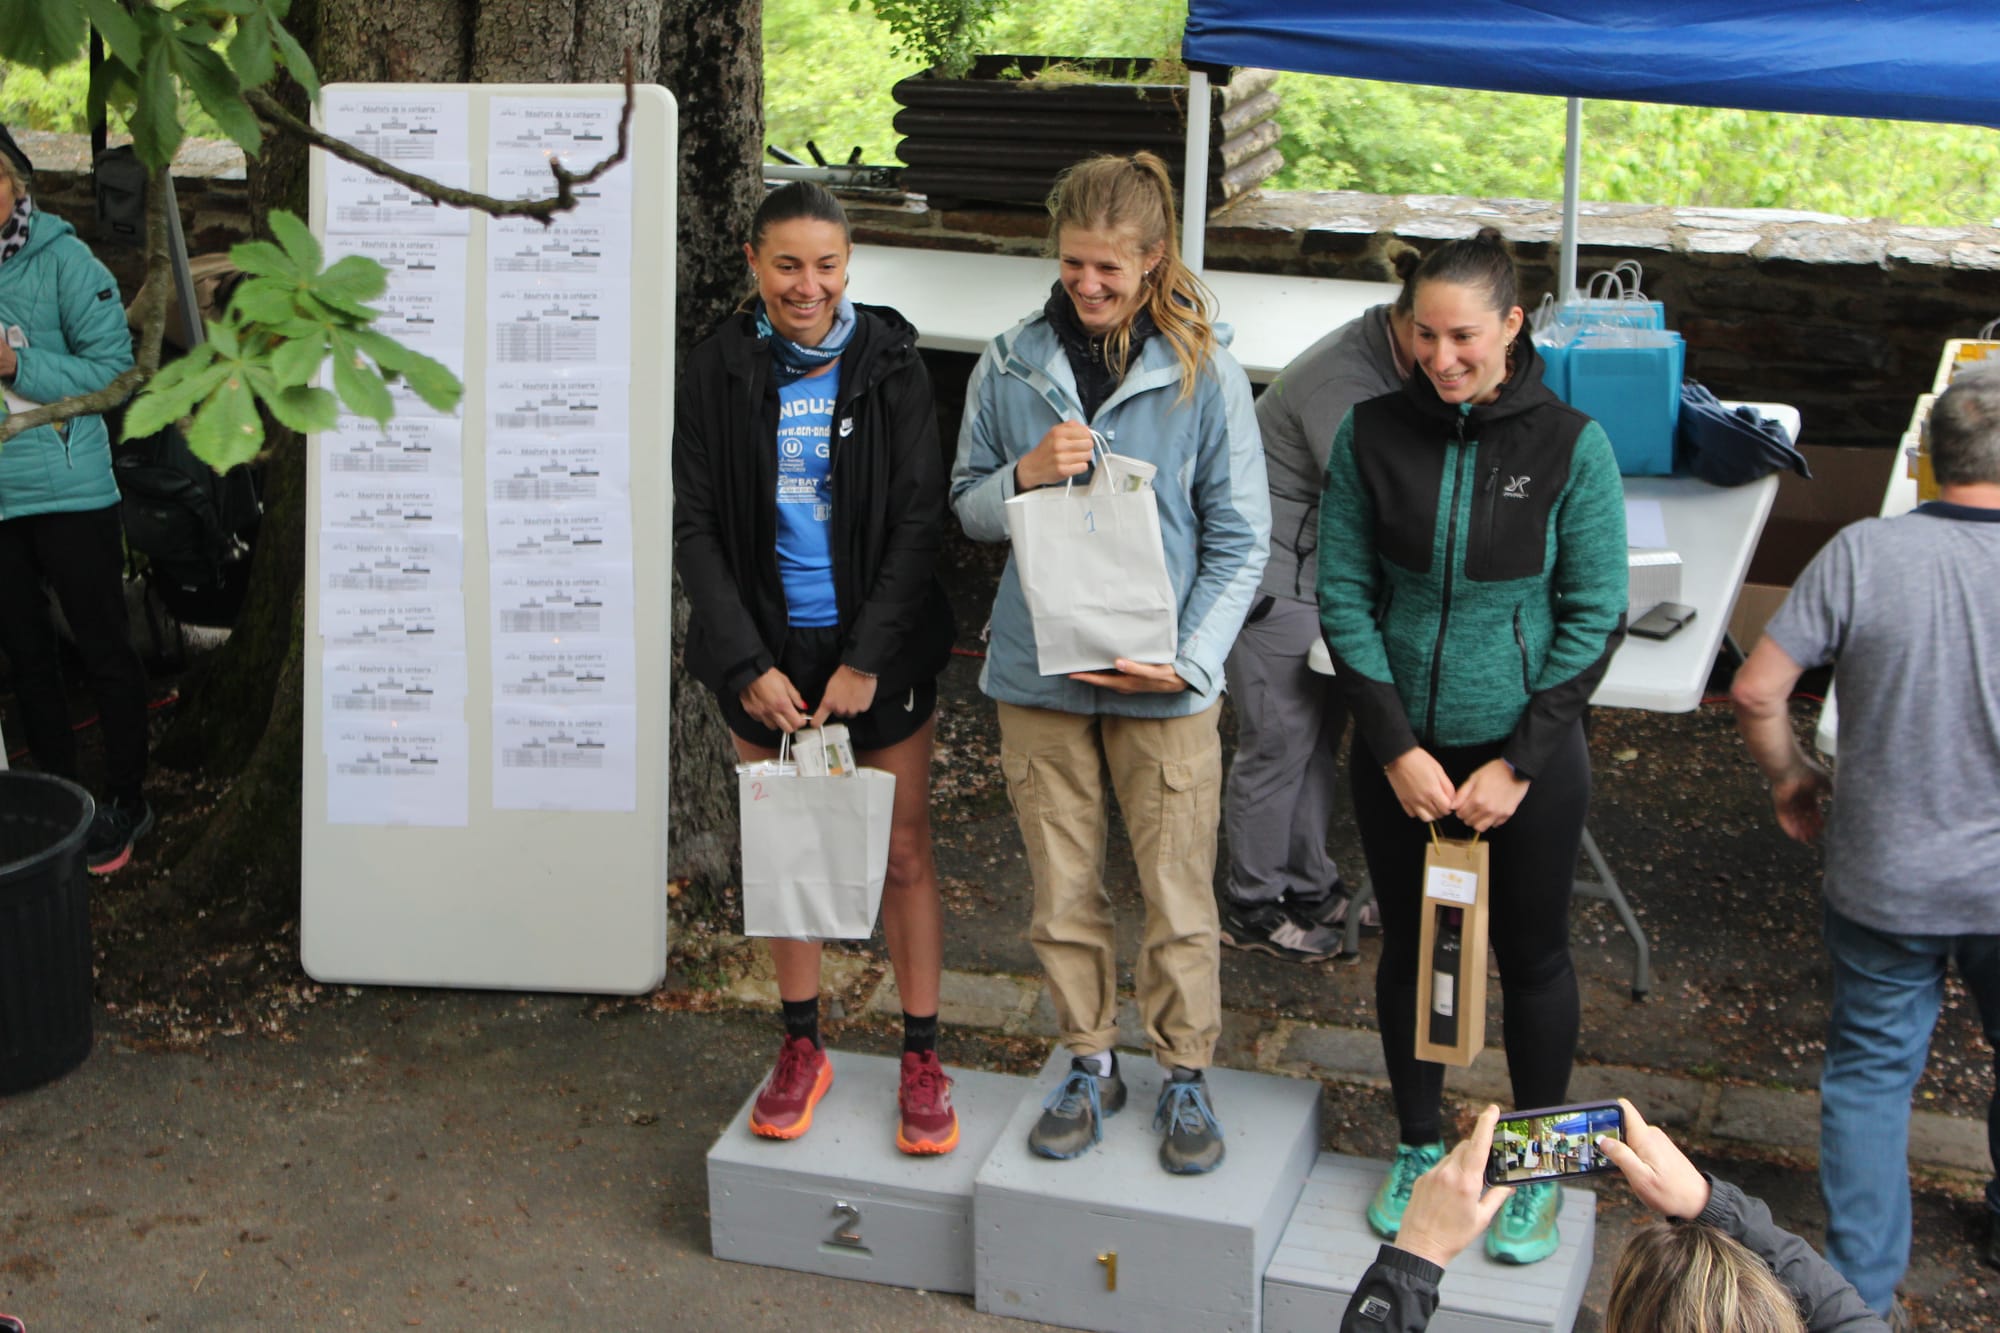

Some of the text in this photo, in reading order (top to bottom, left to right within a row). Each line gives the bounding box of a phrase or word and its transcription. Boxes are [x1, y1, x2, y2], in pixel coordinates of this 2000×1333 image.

[1084, 511, 1097, 533] 1
[751, 782, 769, 801] 2
[832, 1199, 861, 1242] 2
[1096, 1251, 1118, 1292] 1
